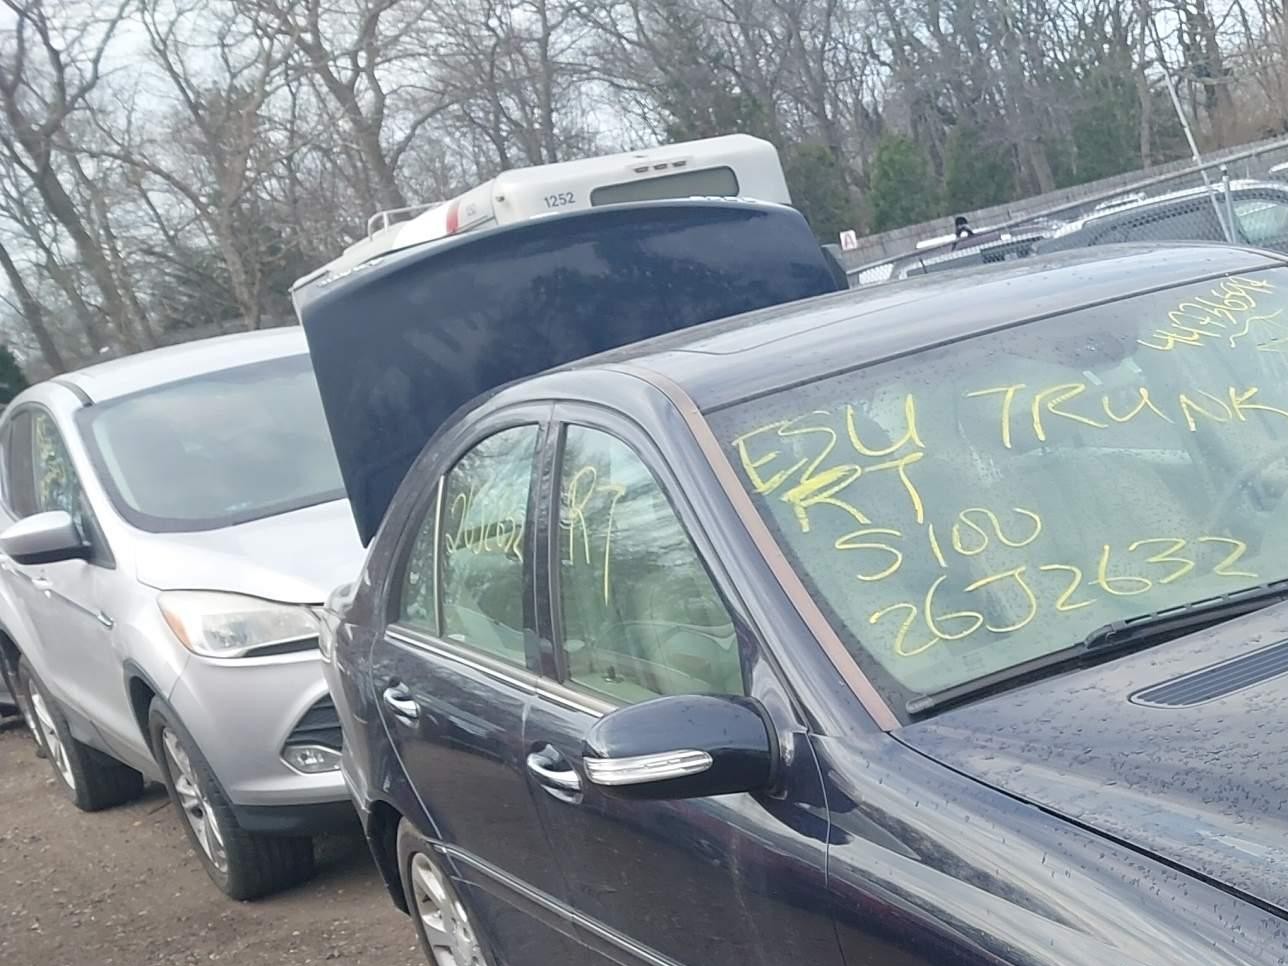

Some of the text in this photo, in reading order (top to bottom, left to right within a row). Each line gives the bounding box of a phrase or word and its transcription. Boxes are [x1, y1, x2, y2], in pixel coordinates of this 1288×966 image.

[543, 191, 577, 208] 1252
[567, 465, 627, 608] RT
[782, 451, 924, 533] RT
[869, 536, 1258, 656] 26J2632
